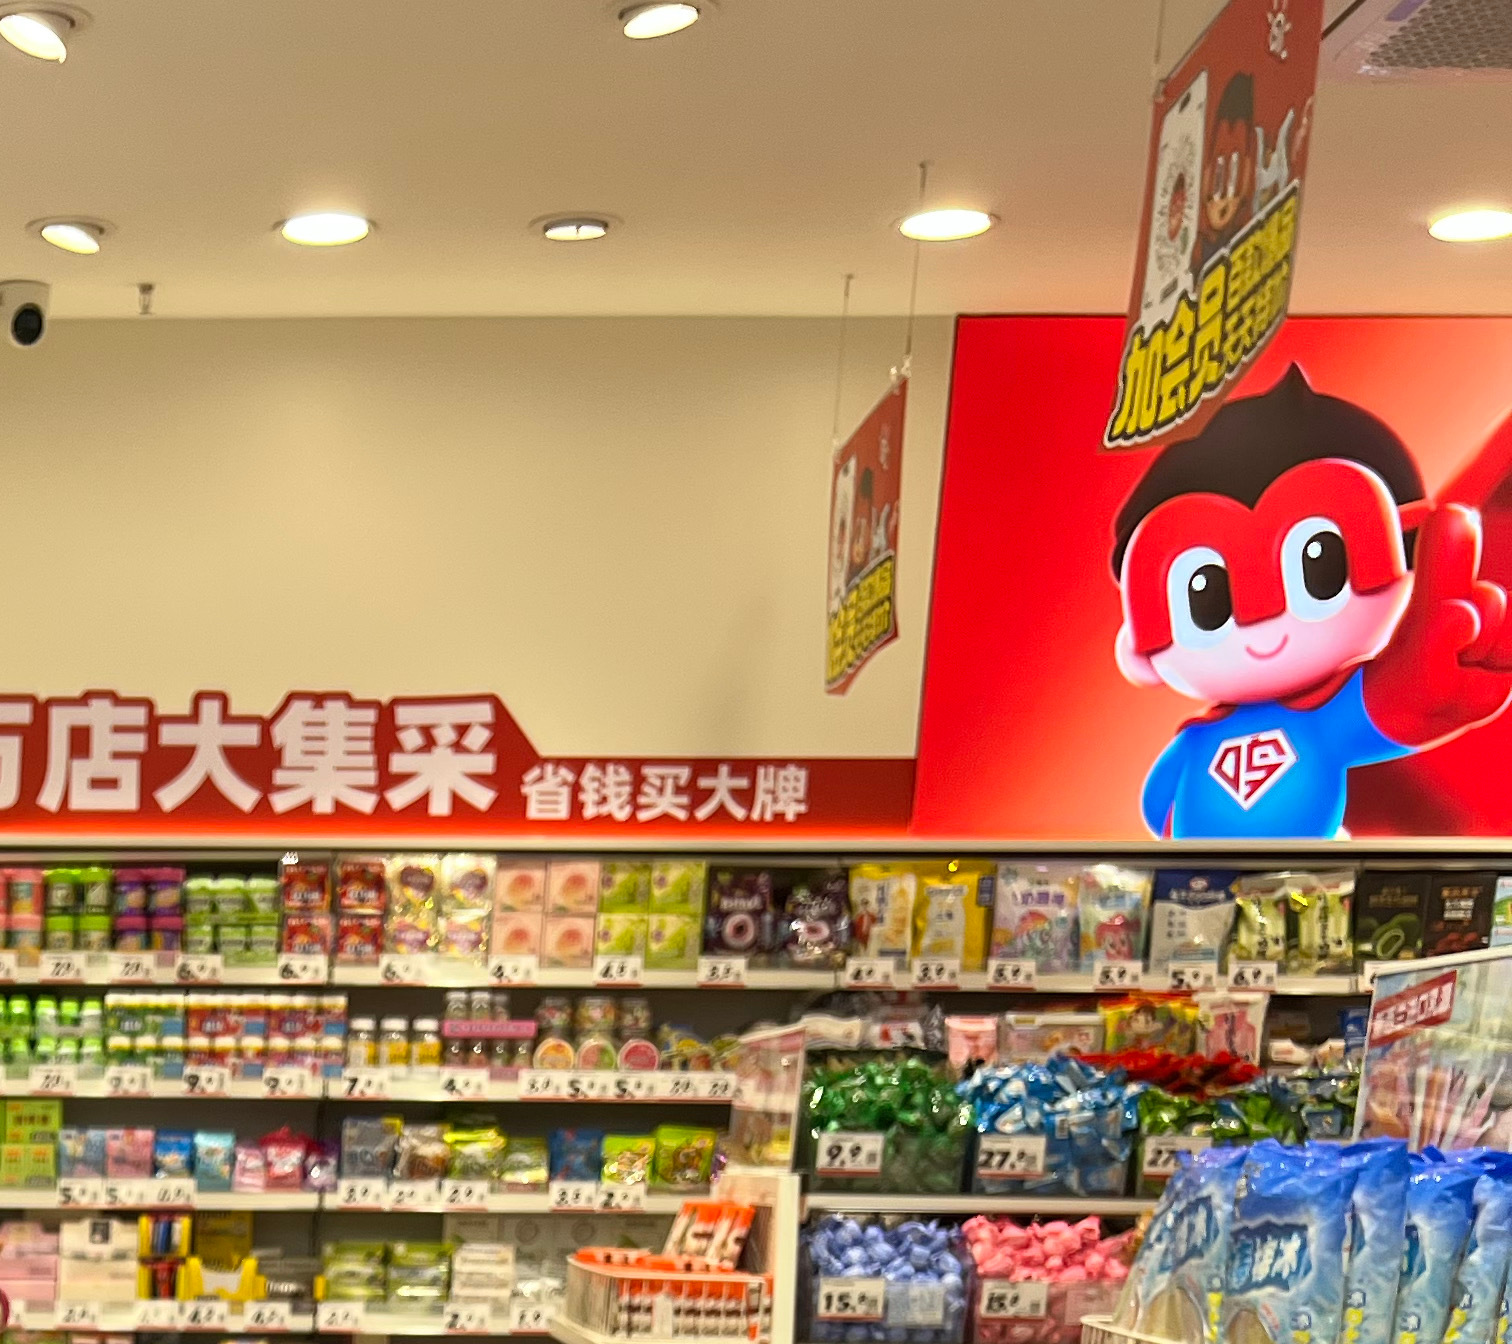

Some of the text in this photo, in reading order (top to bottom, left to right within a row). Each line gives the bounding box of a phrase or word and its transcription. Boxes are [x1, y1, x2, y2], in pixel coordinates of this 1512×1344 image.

[519, 764, 809, 823] 省钱买大牌
